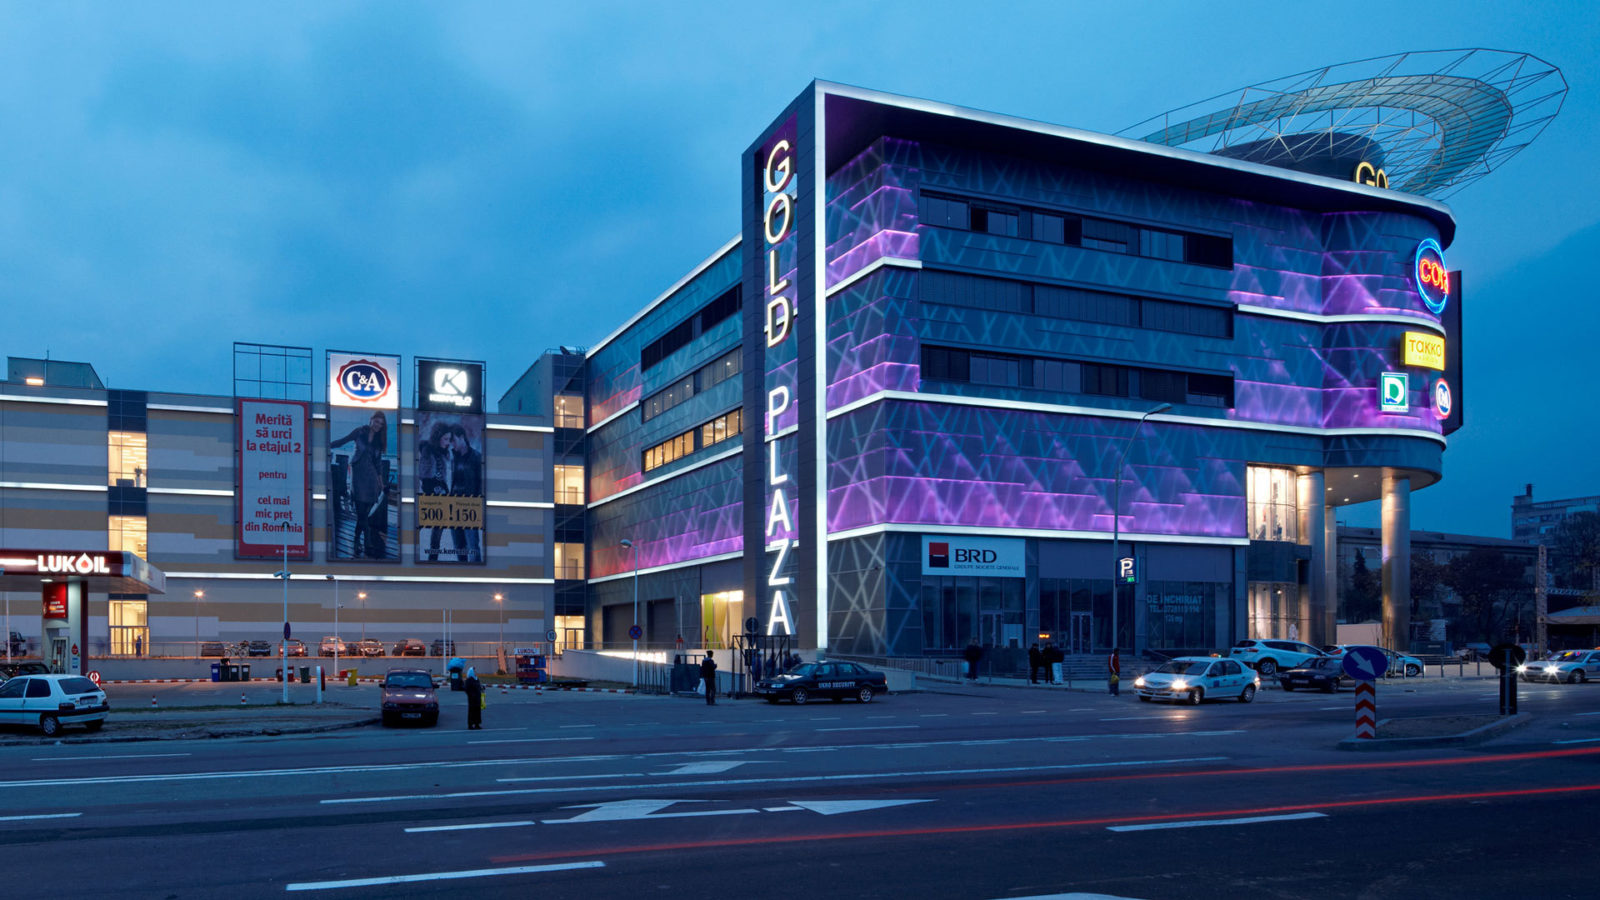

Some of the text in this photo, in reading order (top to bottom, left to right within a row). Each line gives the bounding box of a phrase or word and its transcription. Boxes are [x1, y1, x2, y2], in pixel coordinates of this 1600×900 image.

[346, 370, 382, 392] C&A
[765, 139, 795, 635] GOLD PLAZA
[255, 412, 292, 426] Merită
[256, 426, 292, 440] să urci
[246, 439, 301, 455] la etajul 2
[258, 470, 287, 480] pentru
[257, 495, 290, 505] cel mai
[255, 508, 272, 518] mic
[456, 508, 477, 522] 150
[245, 521, 303, 533] din Romnia
[955, 548, 997, 563] BRD
[37, 552, 110, 574] LUKOIL
